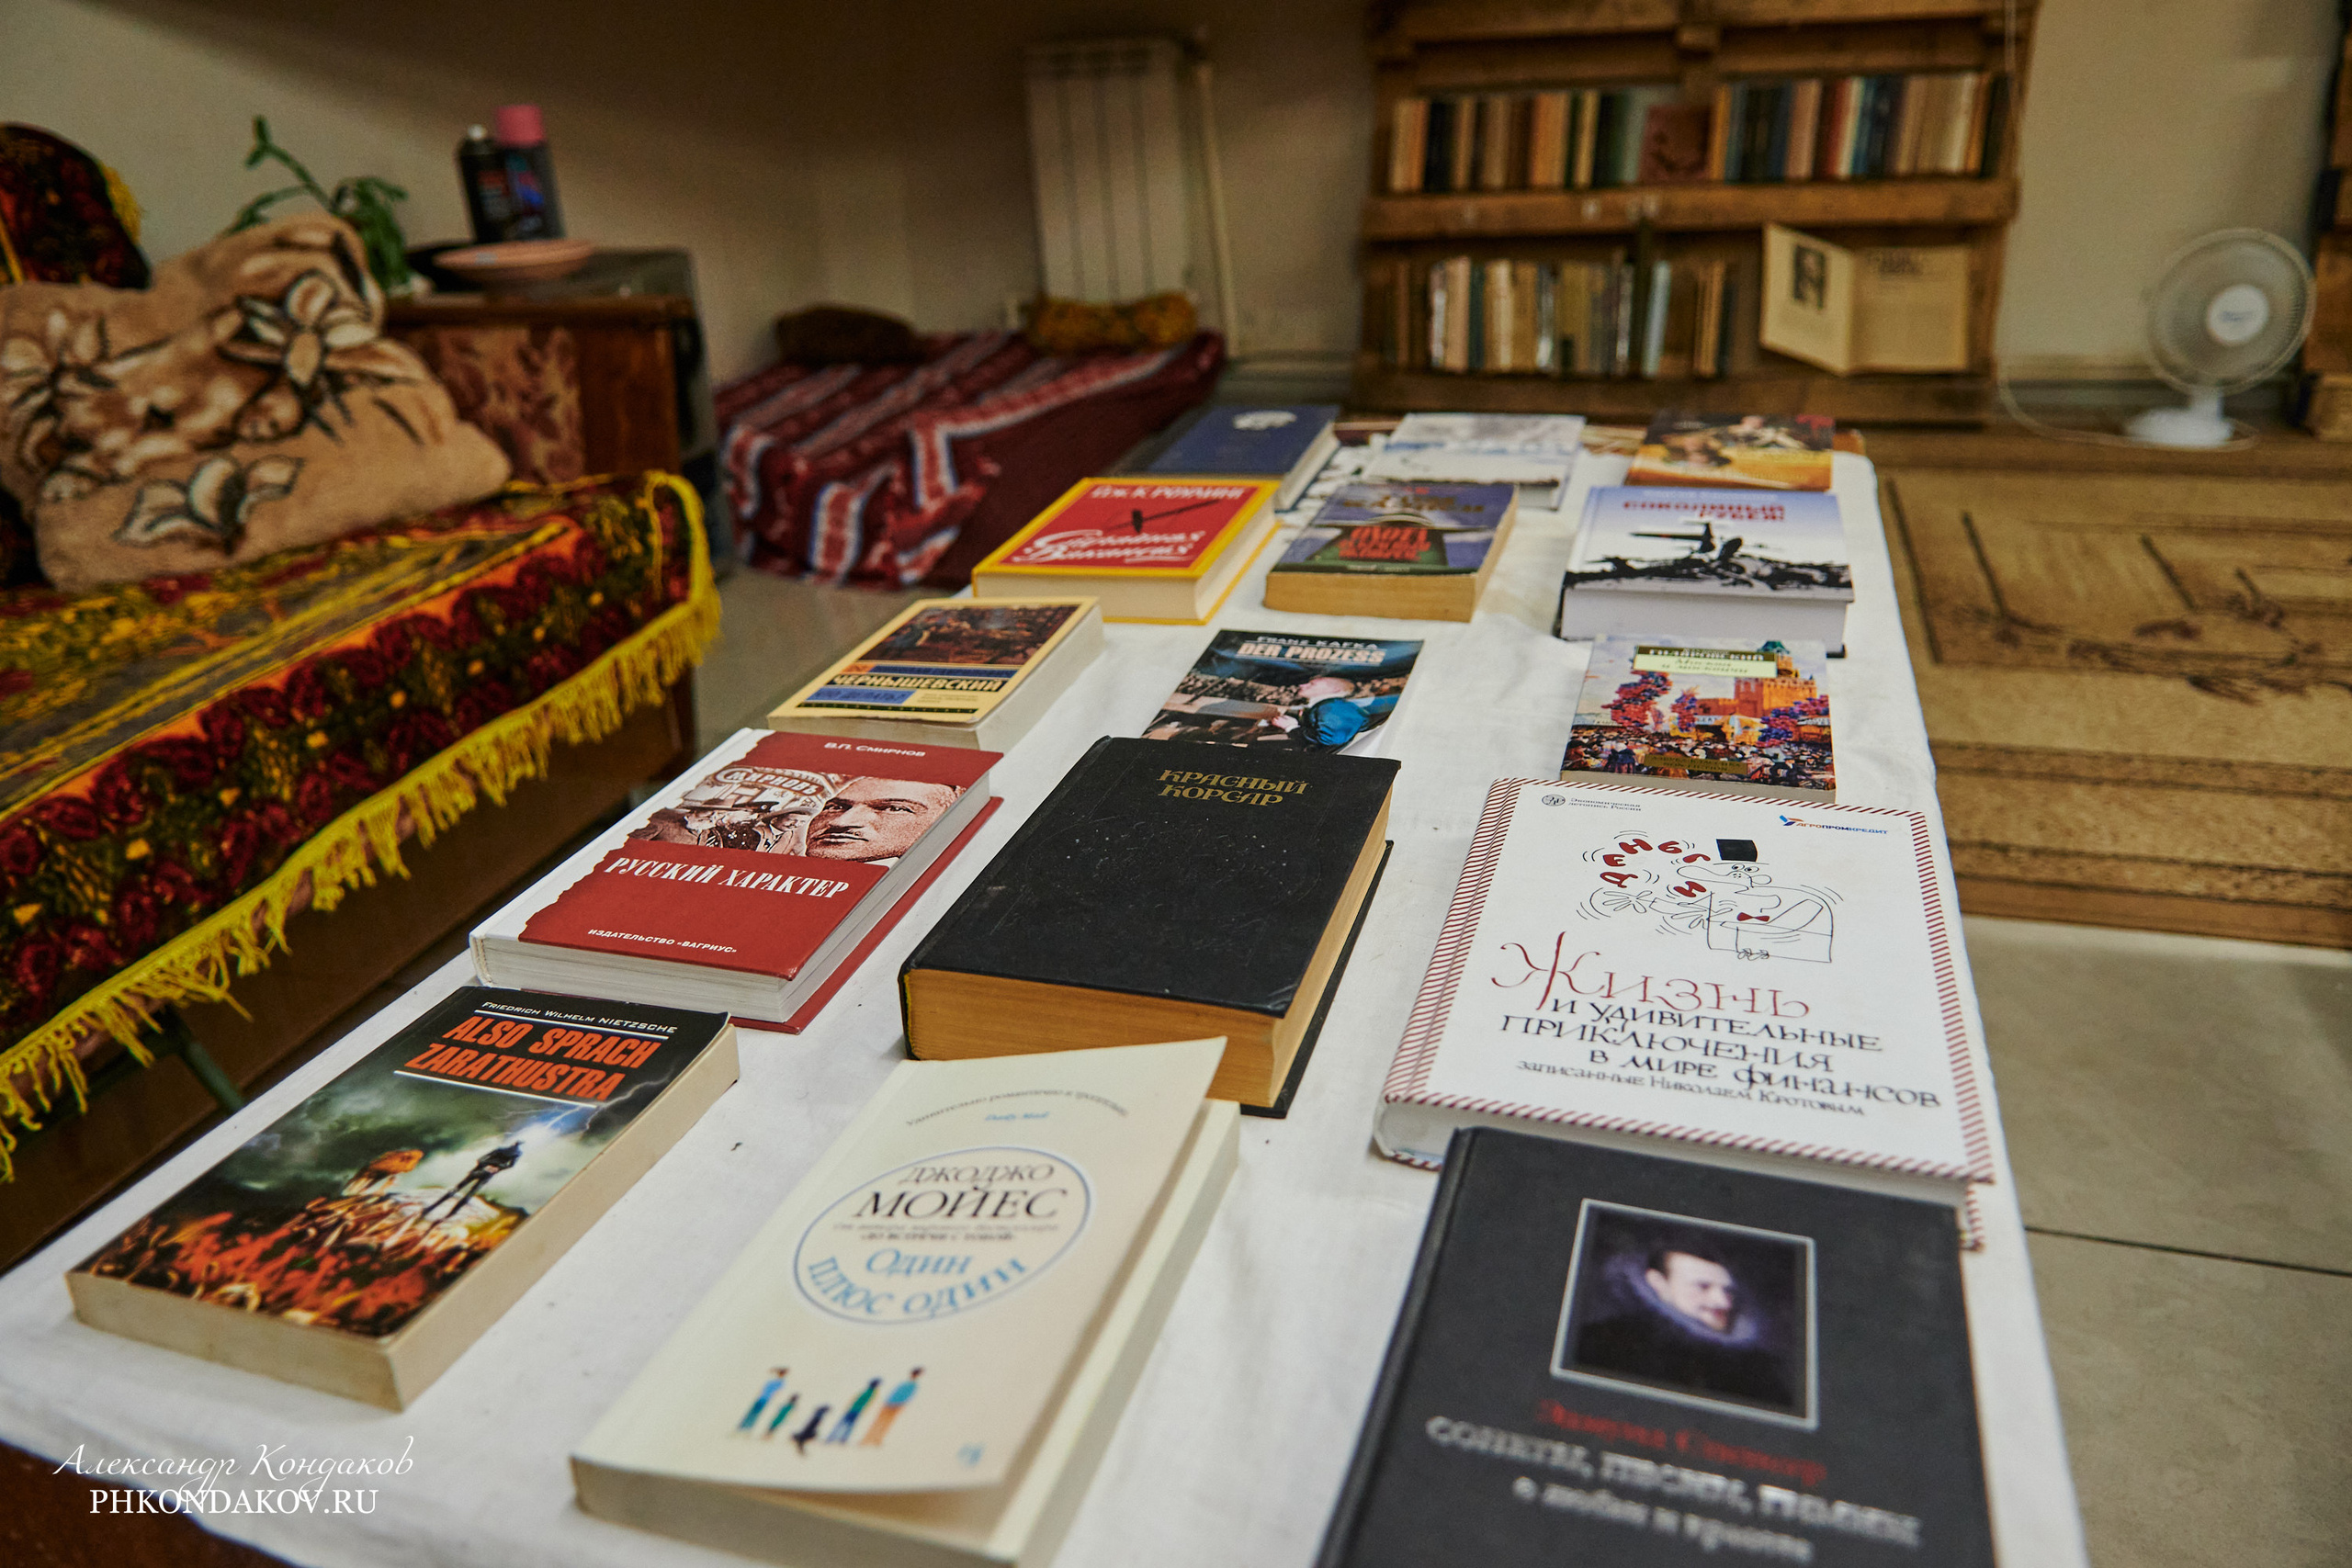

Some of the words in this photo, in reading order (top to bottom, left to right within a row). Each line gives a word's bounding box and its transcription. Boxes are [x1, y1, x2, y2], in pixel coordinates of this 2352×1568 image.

[1237, 643, 1283, 658] DER
[1284, 645, 1386, 664] PROZESS
[831, 673, 1004, 692] ЧЕРНЫШЕВСКИЙ
[824, 741, 853, 750] В.П.
[855, 744, 926, 757] СМИРНОВ
[1157, 769, 1310, 795] КРАСНЫЙ
[1158, 784, 1283, 807] КОРСАР
[604, 856, 725, 885] РУССКИЙ
[718, 868, 850, 898] ХАРАКТЕР
[588, 929, 674, 946] ИЗДАТЕЛЬСТВО
[676, 940, 738, 953] «ВАГРИУС»
[598, 1016, 678, 1033] NIETZSCHE
[441, 1016, 534, 1049] ALSO
[527, 1028, 662, 1068] SPRACH
[1499, 1014, 1834, 1072] ПРИКЛЮЧЕНИЯ
[404, 1043, 626, 1100] ZARATHUSTRA
[1620, 1055, 1718, 1079] МИРЕ
[899, 1163, 1055, 1188] ДЖОДЖО
[853, 1185, 1069, 1219] МОЙЕС
[865, 1247, 974, 1278] Один
